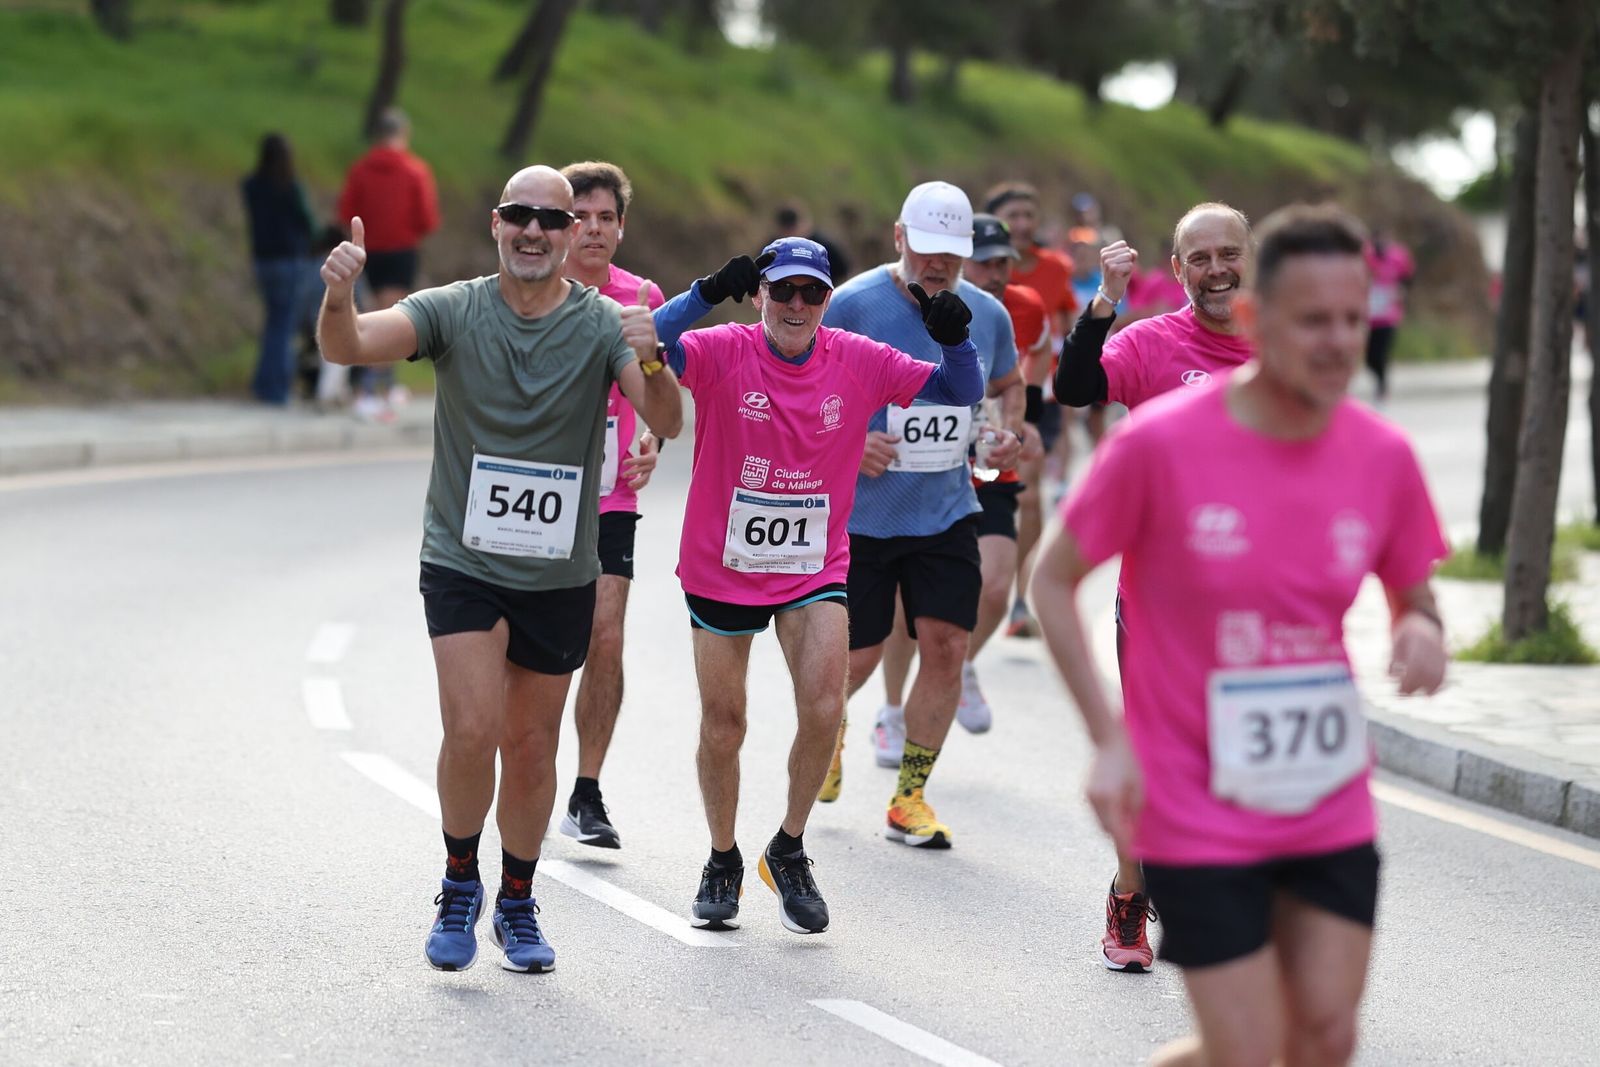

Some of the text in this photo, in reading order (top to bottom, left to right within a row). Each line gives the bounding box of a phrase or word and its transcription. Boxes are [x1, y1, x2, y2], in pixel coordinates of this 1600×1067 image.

[738, 406, 771, 421] HYUNDAI
[903, 415, 959, 443] 642
[771, 479, 823, 490] de Málaga
[774, 468, 812, 479] Ciudad
[486, 484, 562, 524] 540
[744, 516, 811, 547] 601
[1244, 704, 1347, 763] 370
